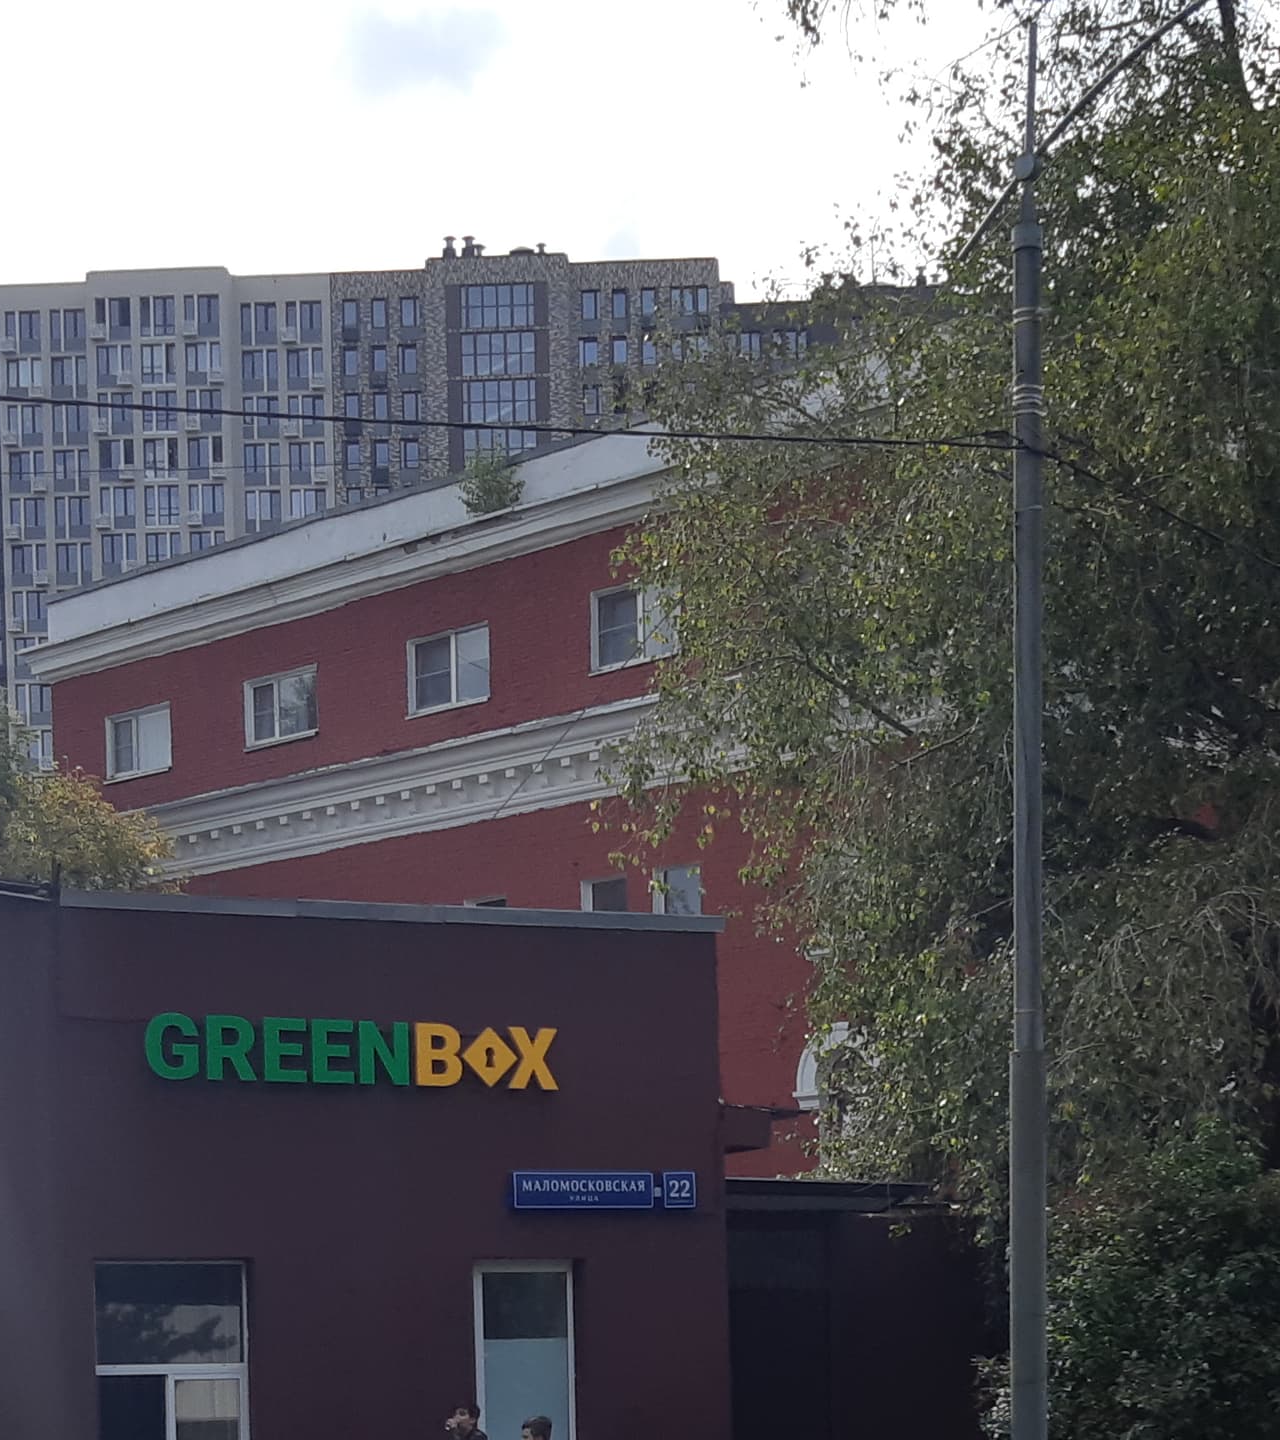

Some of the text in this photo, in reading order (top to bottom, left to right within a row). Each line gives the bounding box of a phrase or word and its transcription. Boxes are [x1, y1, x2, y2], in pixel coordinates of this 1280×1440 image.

[144, 1012, 560, 1091] GREENBOX
[522, 1179, 646, 1192] МАЛОМОСКОВСКАЯ
[669, 1180, 691, 1198] 22
